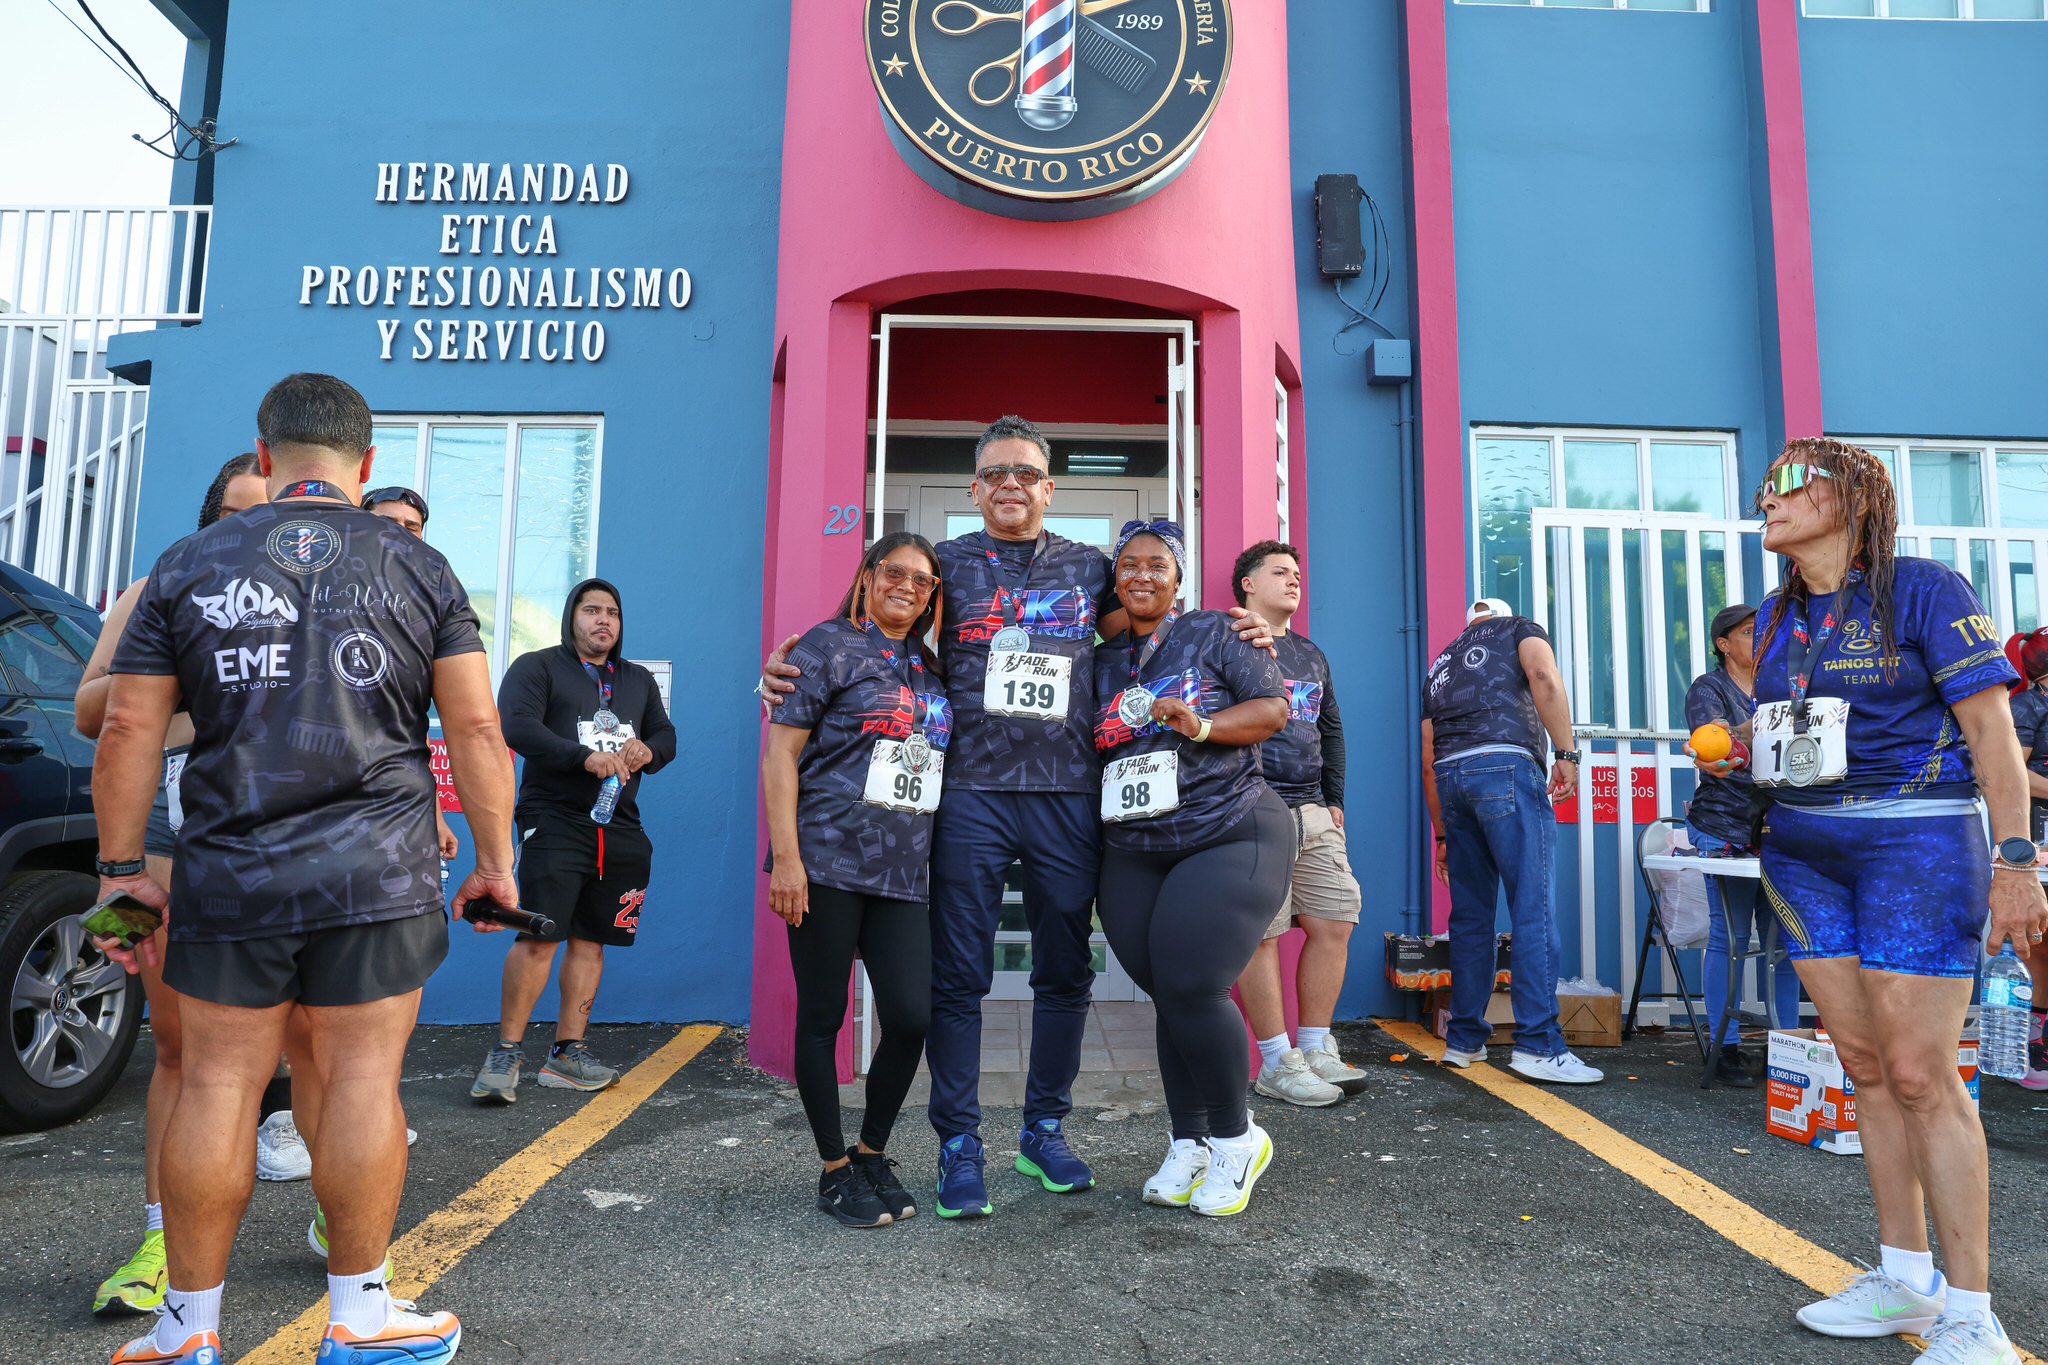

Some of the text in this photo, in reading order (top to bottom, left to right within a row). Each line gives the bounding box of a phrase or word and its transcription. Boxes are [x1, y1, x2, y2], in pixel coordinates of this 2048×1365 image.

[1114, 13, 1164, 31] 1989
[922, 117, 1164, 184] PUERTO RICO
[375, 162, 630, 203] HERMANDAD
[439, 214, 558, 255] ETICA
[299, 265, 692, 308] PROFESIONALISMO
[377, 318, 606, 361] Y SERVICIO
[823, 504, 861, 535] 29
[312, 607, 375, 617] NUTRITION
[958, 626, 1003, 643] FAD
[214, 644, 292, 683] EME
[1019, 654, 1050, 667] FADE
[1823, 658, 1874, 671] TAINOS
[1032, 666, 1059, 678] RUN
[1843, 674, 1880, 685] TEAM
[231, 680, 278, 693] STUDIO
[1003, 680, 1055, 709] 139
[1780, 702, 1814, 718] FAE
[1807, 715, 1824, 727] UN
[1125, 755, 1152, 769] FADE
[1790, 751, 1809, 765] 5K
[1137, 763, 1160, 776] RUN
[893, 773, 923, 803] 96
[1121, 781, 1151, 810] 98
[1771, 1036, 1806, 1050] MARATHON
[1770, 1068, 1789, 1080] 6,000
[1770, 1088, 1800, 1101] TOILET PAPER
